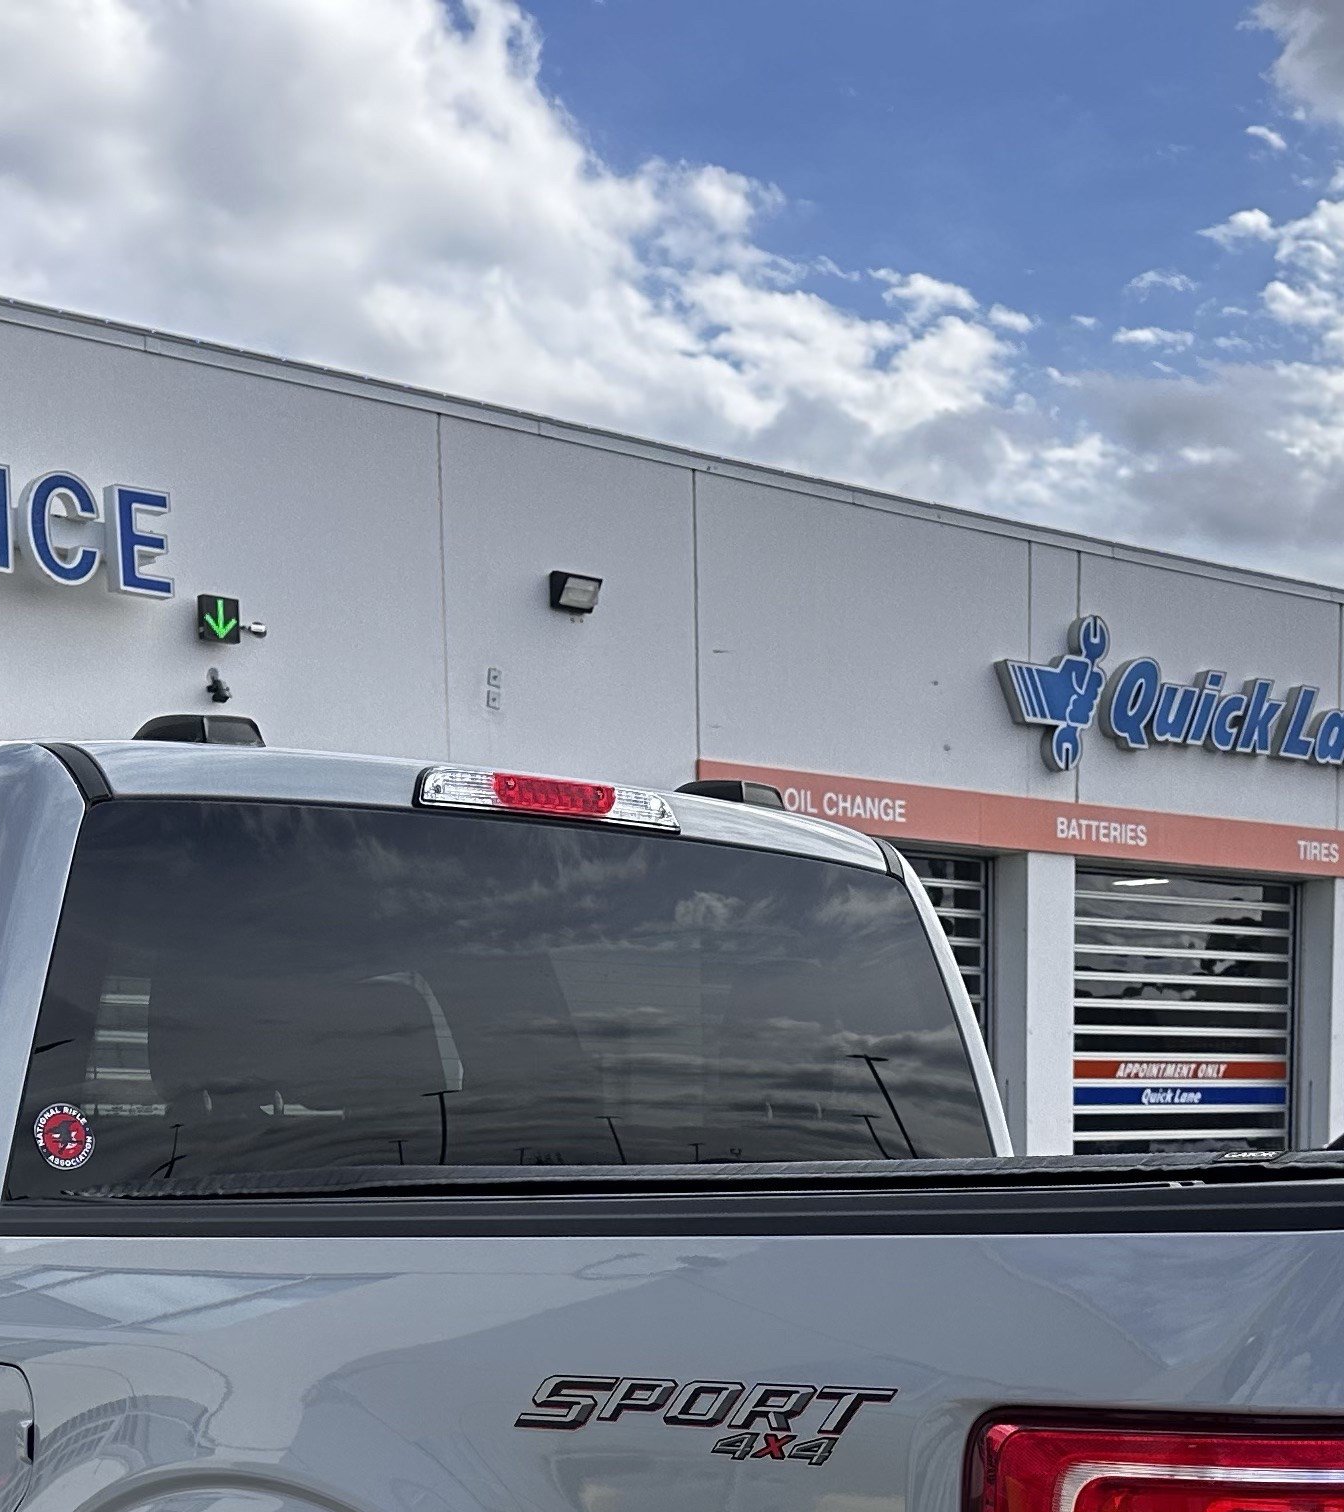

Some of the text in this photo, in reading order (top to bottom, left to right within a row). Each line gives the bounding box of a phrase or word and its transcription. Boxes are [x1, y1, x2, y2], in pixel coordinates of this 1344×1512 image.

[1104, 656, 1285, 751] Quick
[783, 787, 907, 823] OIL CHANGE
[1056, 816, 1148, 847] BATTERIES
[1297, 839, 1340, 863] TIRES
[1116, 1062, 1228, 1078] APPOINTMENT ONLY
[1141, 1088, 1202, 1105] Quick Lane
[36, 1106, 62, 1147] NATIONAL
[62, 1106, 88, 1126] RIFLE
[513, 1373, 899, 1436] SPORT
